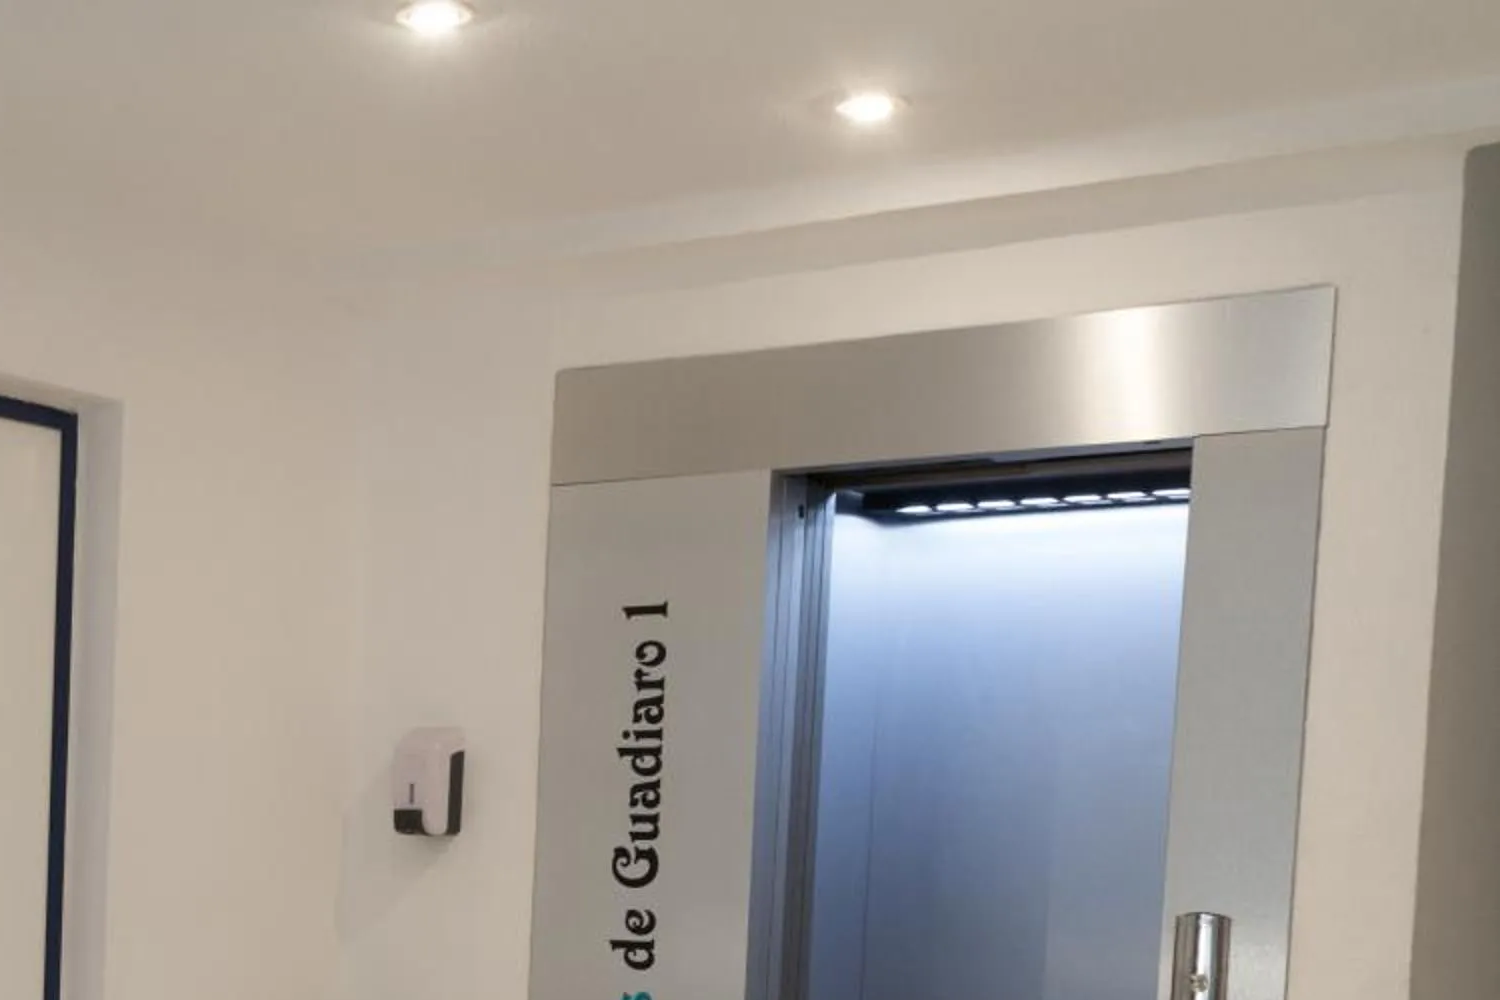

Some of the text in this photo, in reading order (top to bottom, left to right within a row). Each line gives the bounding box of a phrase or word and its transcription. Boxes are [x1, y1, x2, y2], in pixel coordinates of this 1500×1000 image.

[622, 600, 669, 620] 1
[611, 638, 668, 889] Guadiaro
[610, 908, 657, 972] de
